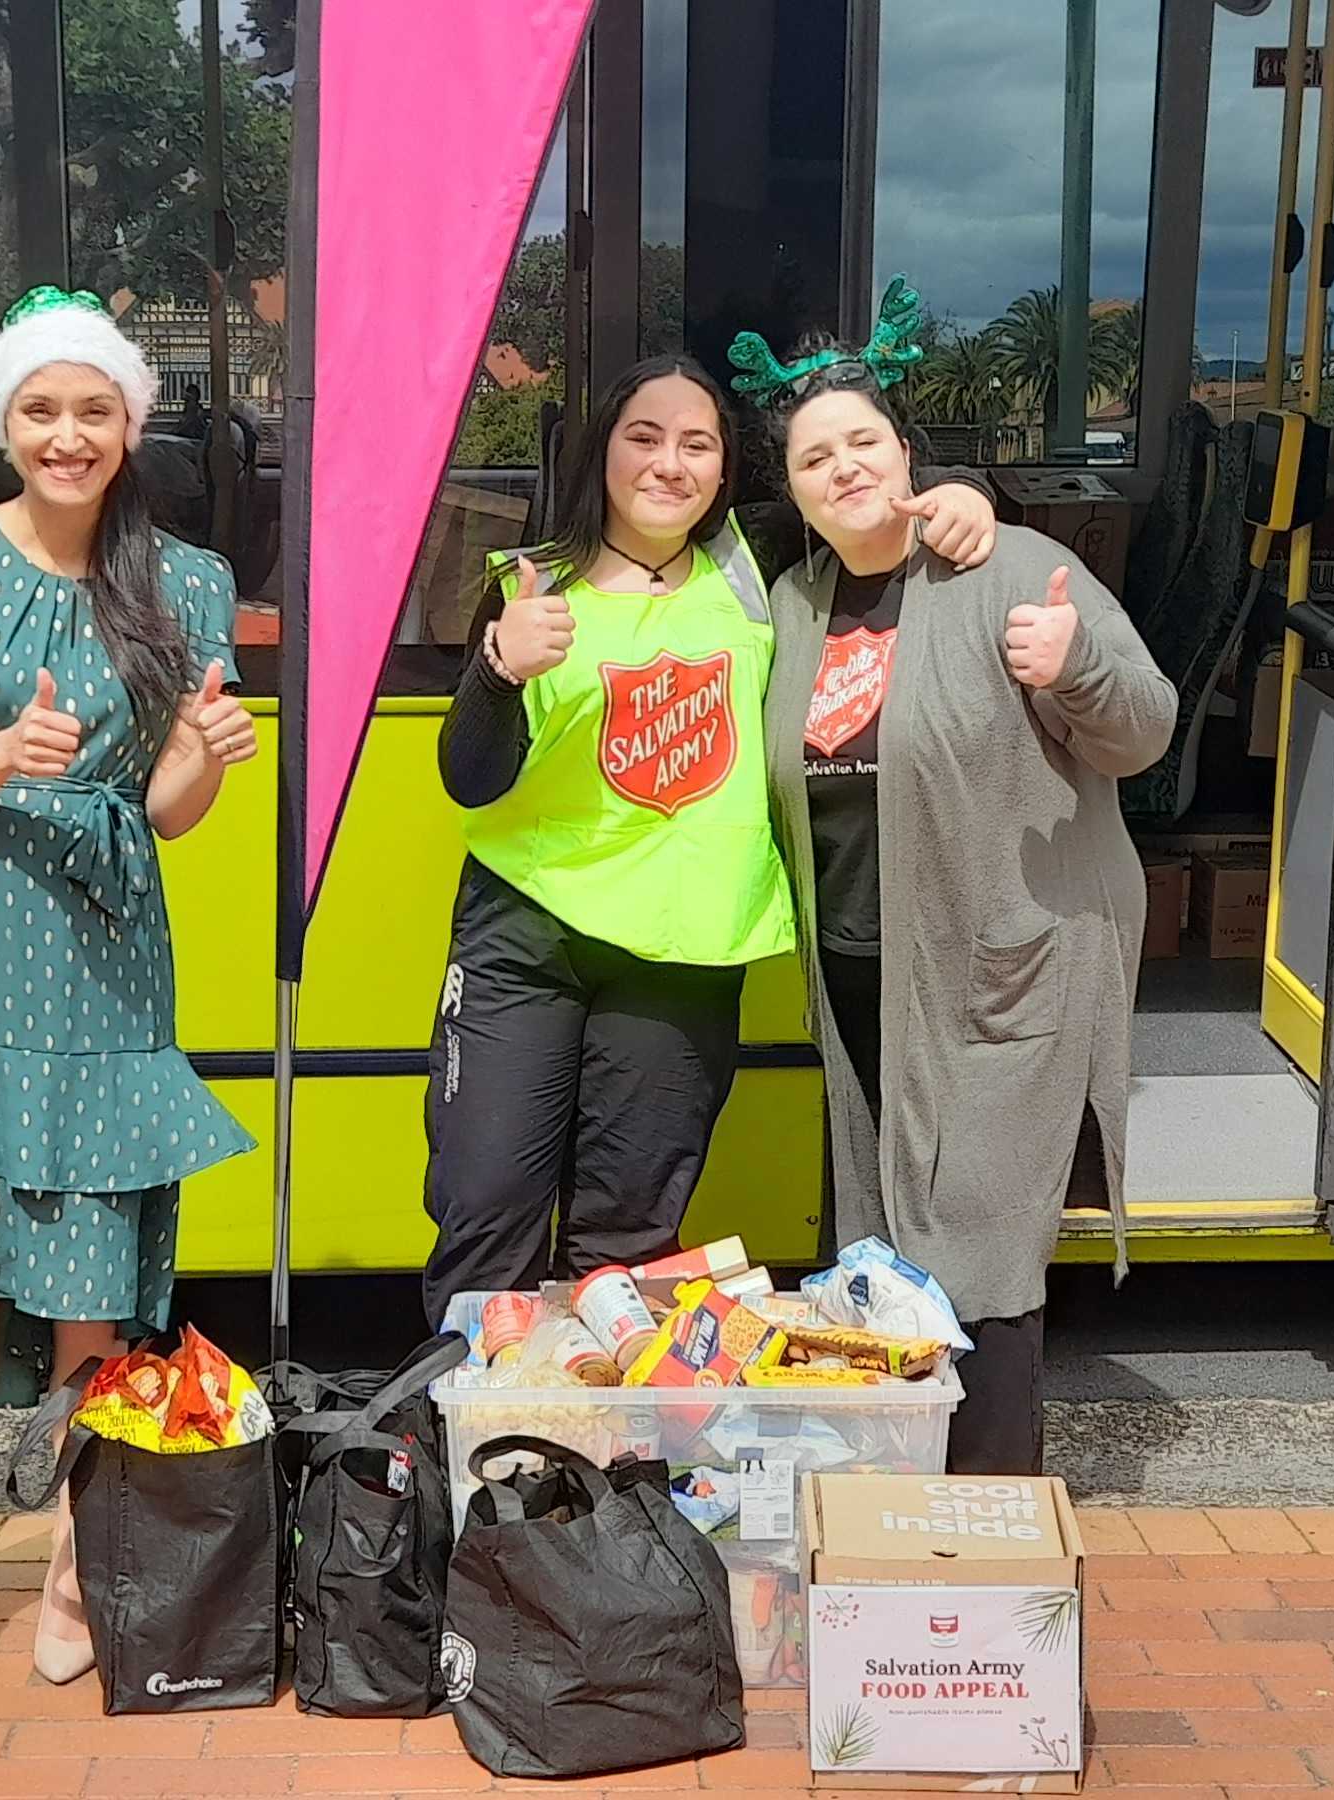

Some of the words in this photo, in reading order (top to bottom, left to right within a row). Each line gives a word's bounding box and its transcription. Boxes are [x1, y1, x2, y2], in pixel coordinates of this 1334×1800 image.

[630, 666, 677, 720] THE
[608, 670, 723, 774] SALVATION
[653, 717, 719, 796] ARMY
[855, 759, 879, 775] Arm
[922, 1481, 1035, 1500] cool
[928, 1499, 1039, 1520] stuff
[880, 1510, 1043, 1541] inside
[865, 1658, 961, 1676] Salvation
[967, 1659, 1025, 1680] Army
[861, 1682, 927, 1698] FOOD
[934, 1682, 1030, 1698] APPEAL
